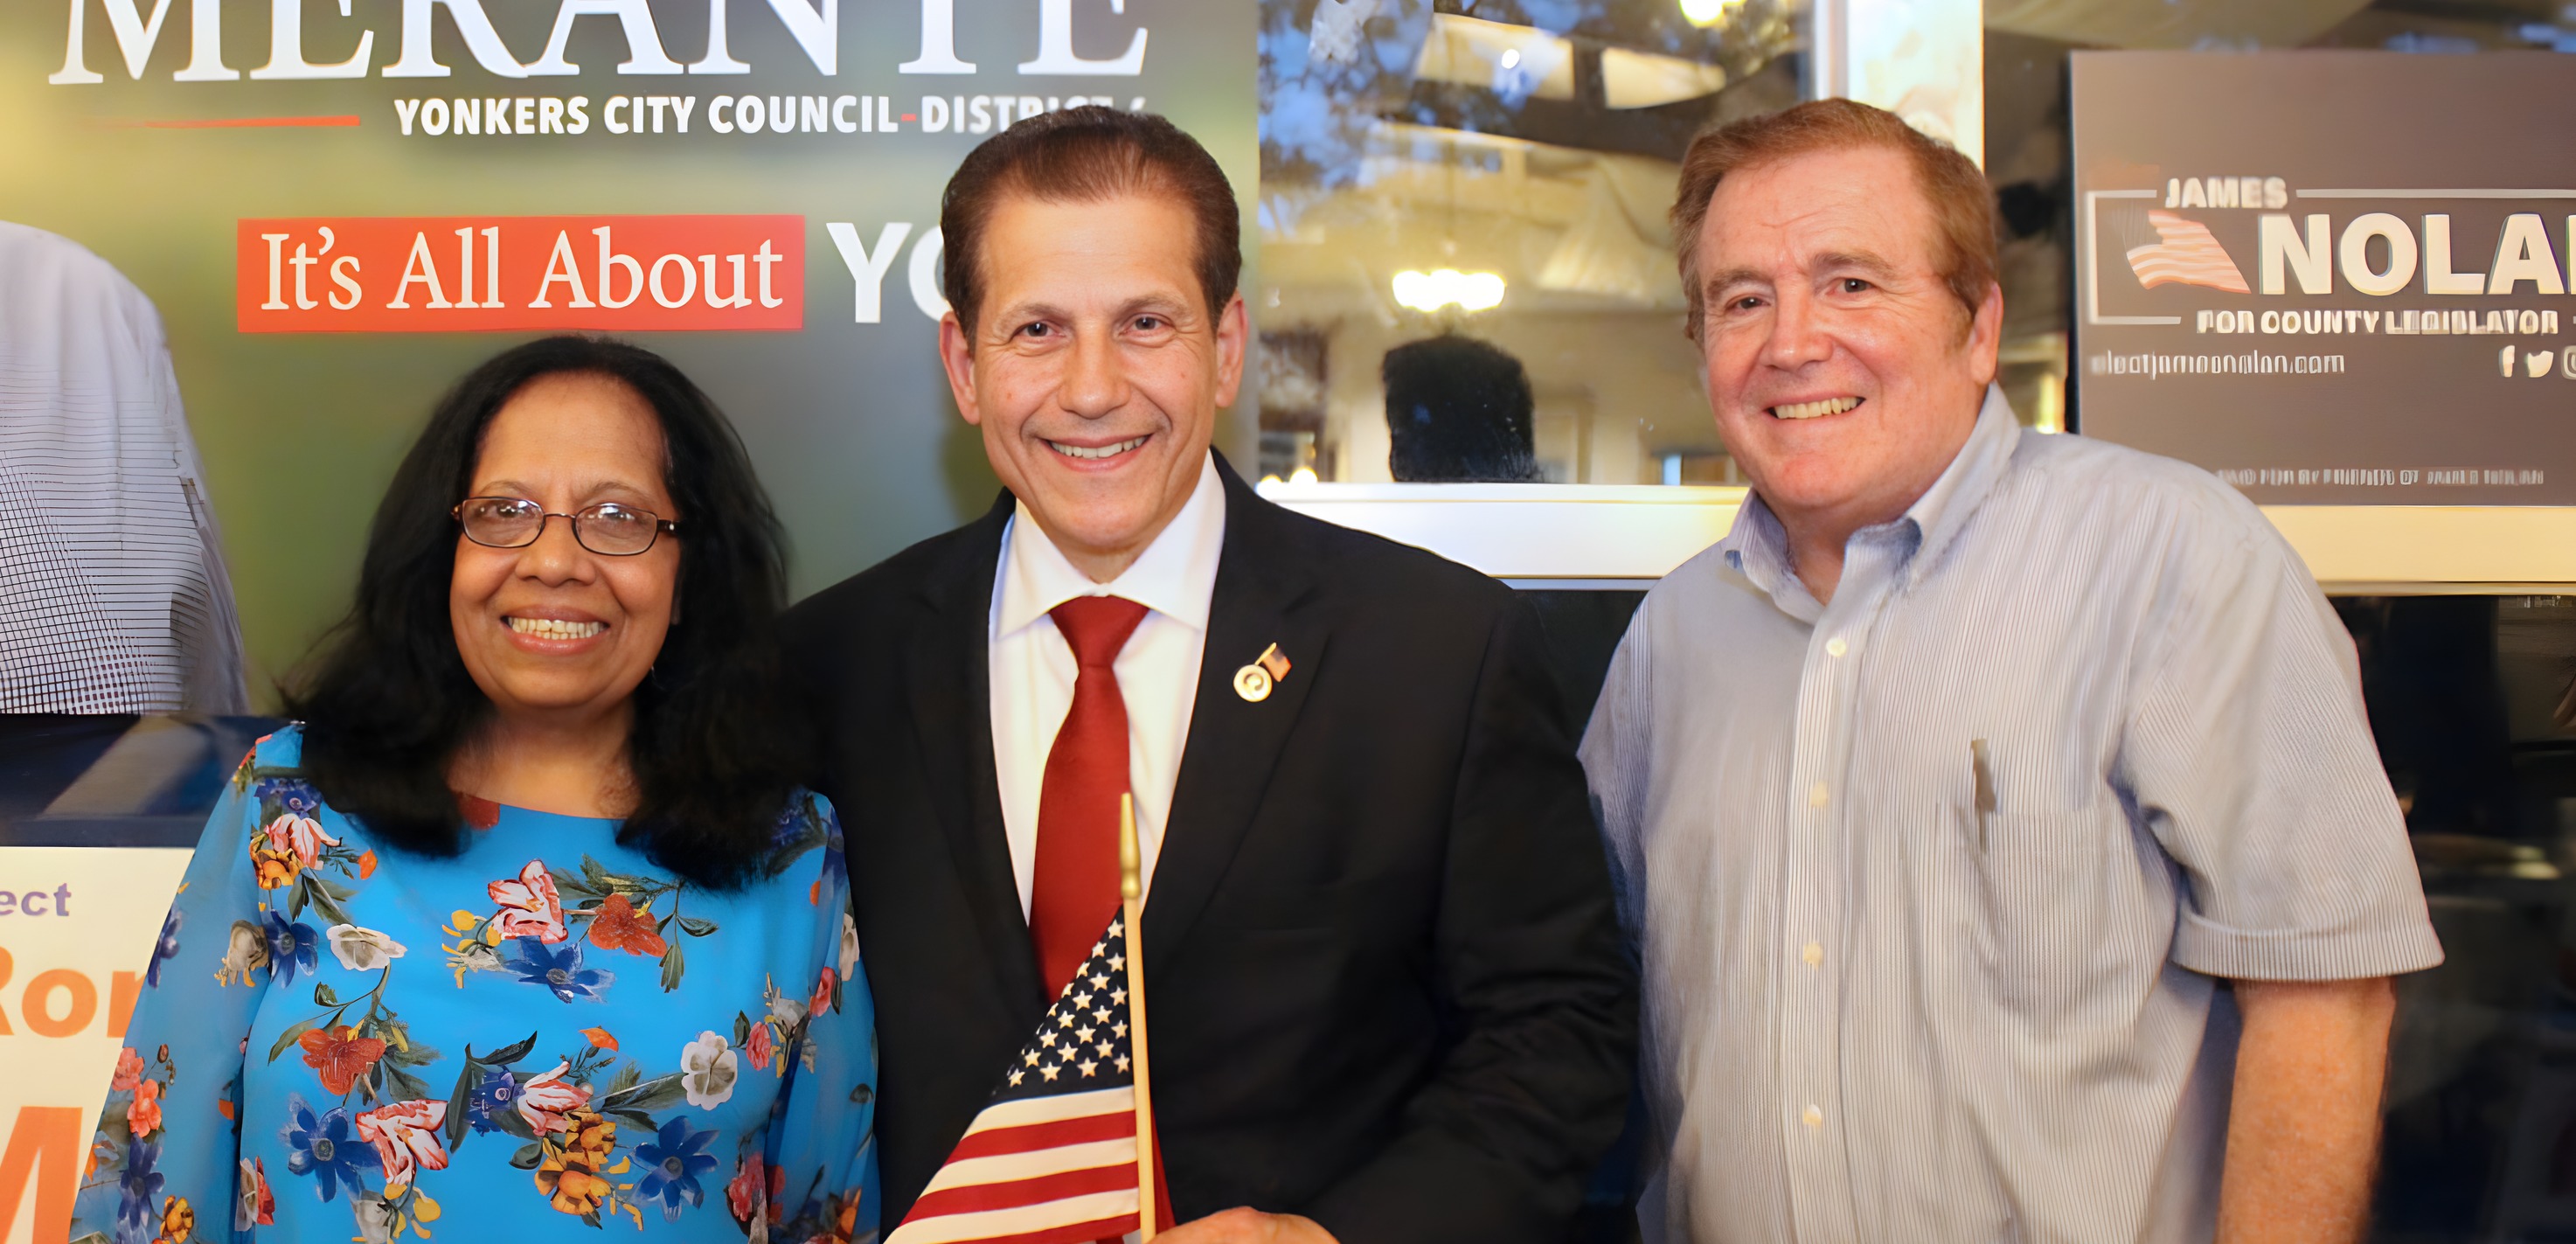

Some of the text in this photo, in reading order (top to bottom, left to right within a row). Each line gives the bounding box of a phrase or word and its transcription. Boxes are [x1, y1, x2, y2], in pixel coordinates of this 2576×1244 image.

[394, 97, 590, 135] YONKERS
[603, 96, 697, 134] CITY
[2166, 177, 2288, 210] JAMES
[260, 225, 783, 310] It's All About
[2259, 212, 2576, 295] NOLA
[2260, 309, 2380, 335] COUNTY
